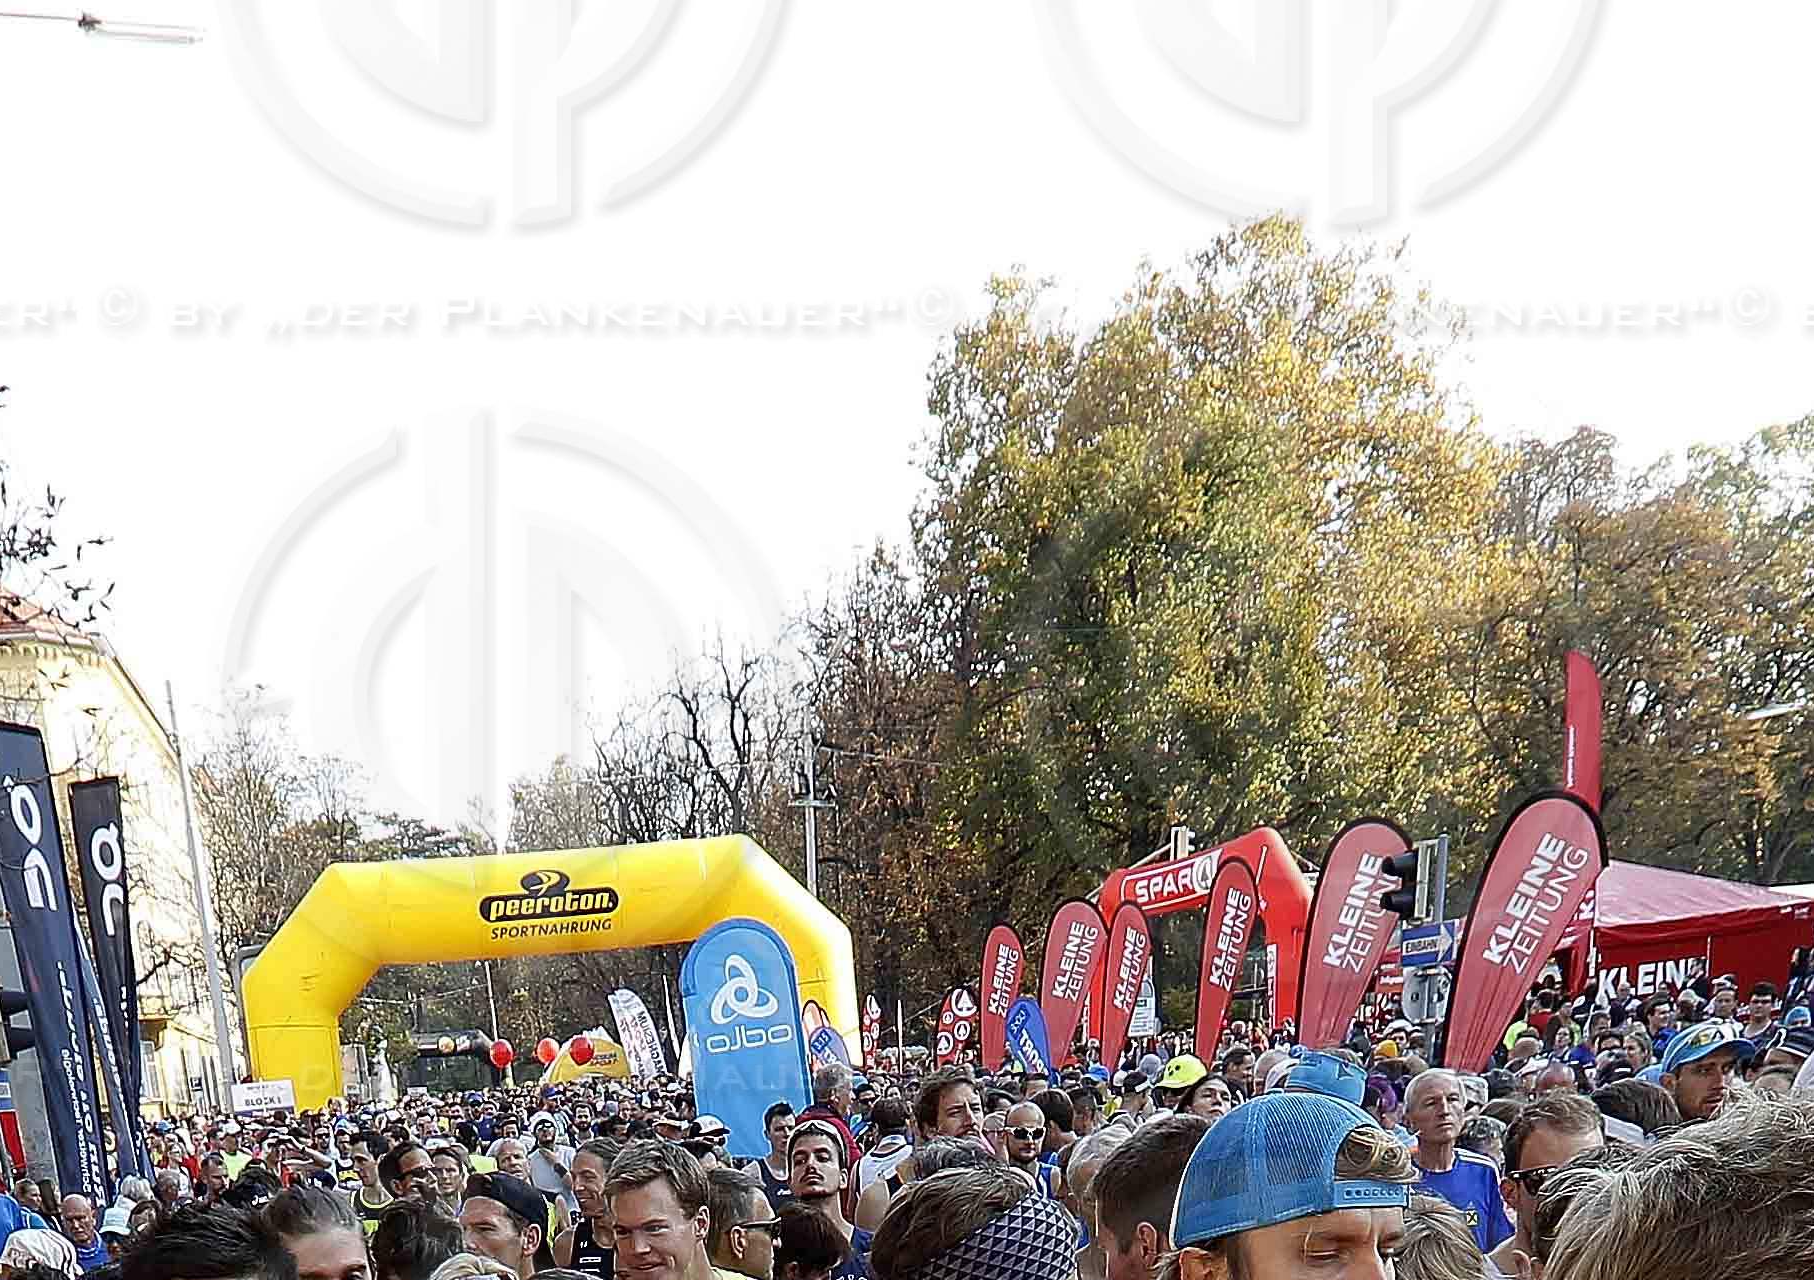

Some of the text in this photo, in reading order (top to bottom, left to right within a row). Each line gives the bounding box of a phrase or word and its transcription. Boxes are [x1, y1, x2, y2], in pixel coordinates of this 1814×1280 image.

[1135, 873, 1192, 902] SPAR
[1323, 853, 1385, 966] KLEINE
[1342, 872, 1402, 973] ZEITUN
[1483, 832, 1566, 965] KLEINE
[491, 918, 612, 940] SPORTNAHRUNG
[1052, 921, 1085, 998] KLEINE
[1113, 927, 1137, 1007] KLEINE
[1210, 888, 1242, 985] KLEINE
[1406, 937, 1438, 953] EINBAHN
[988, 944, 1011, 1014] KLEINE
[1598, 958, 1693, 999] KLEIN
